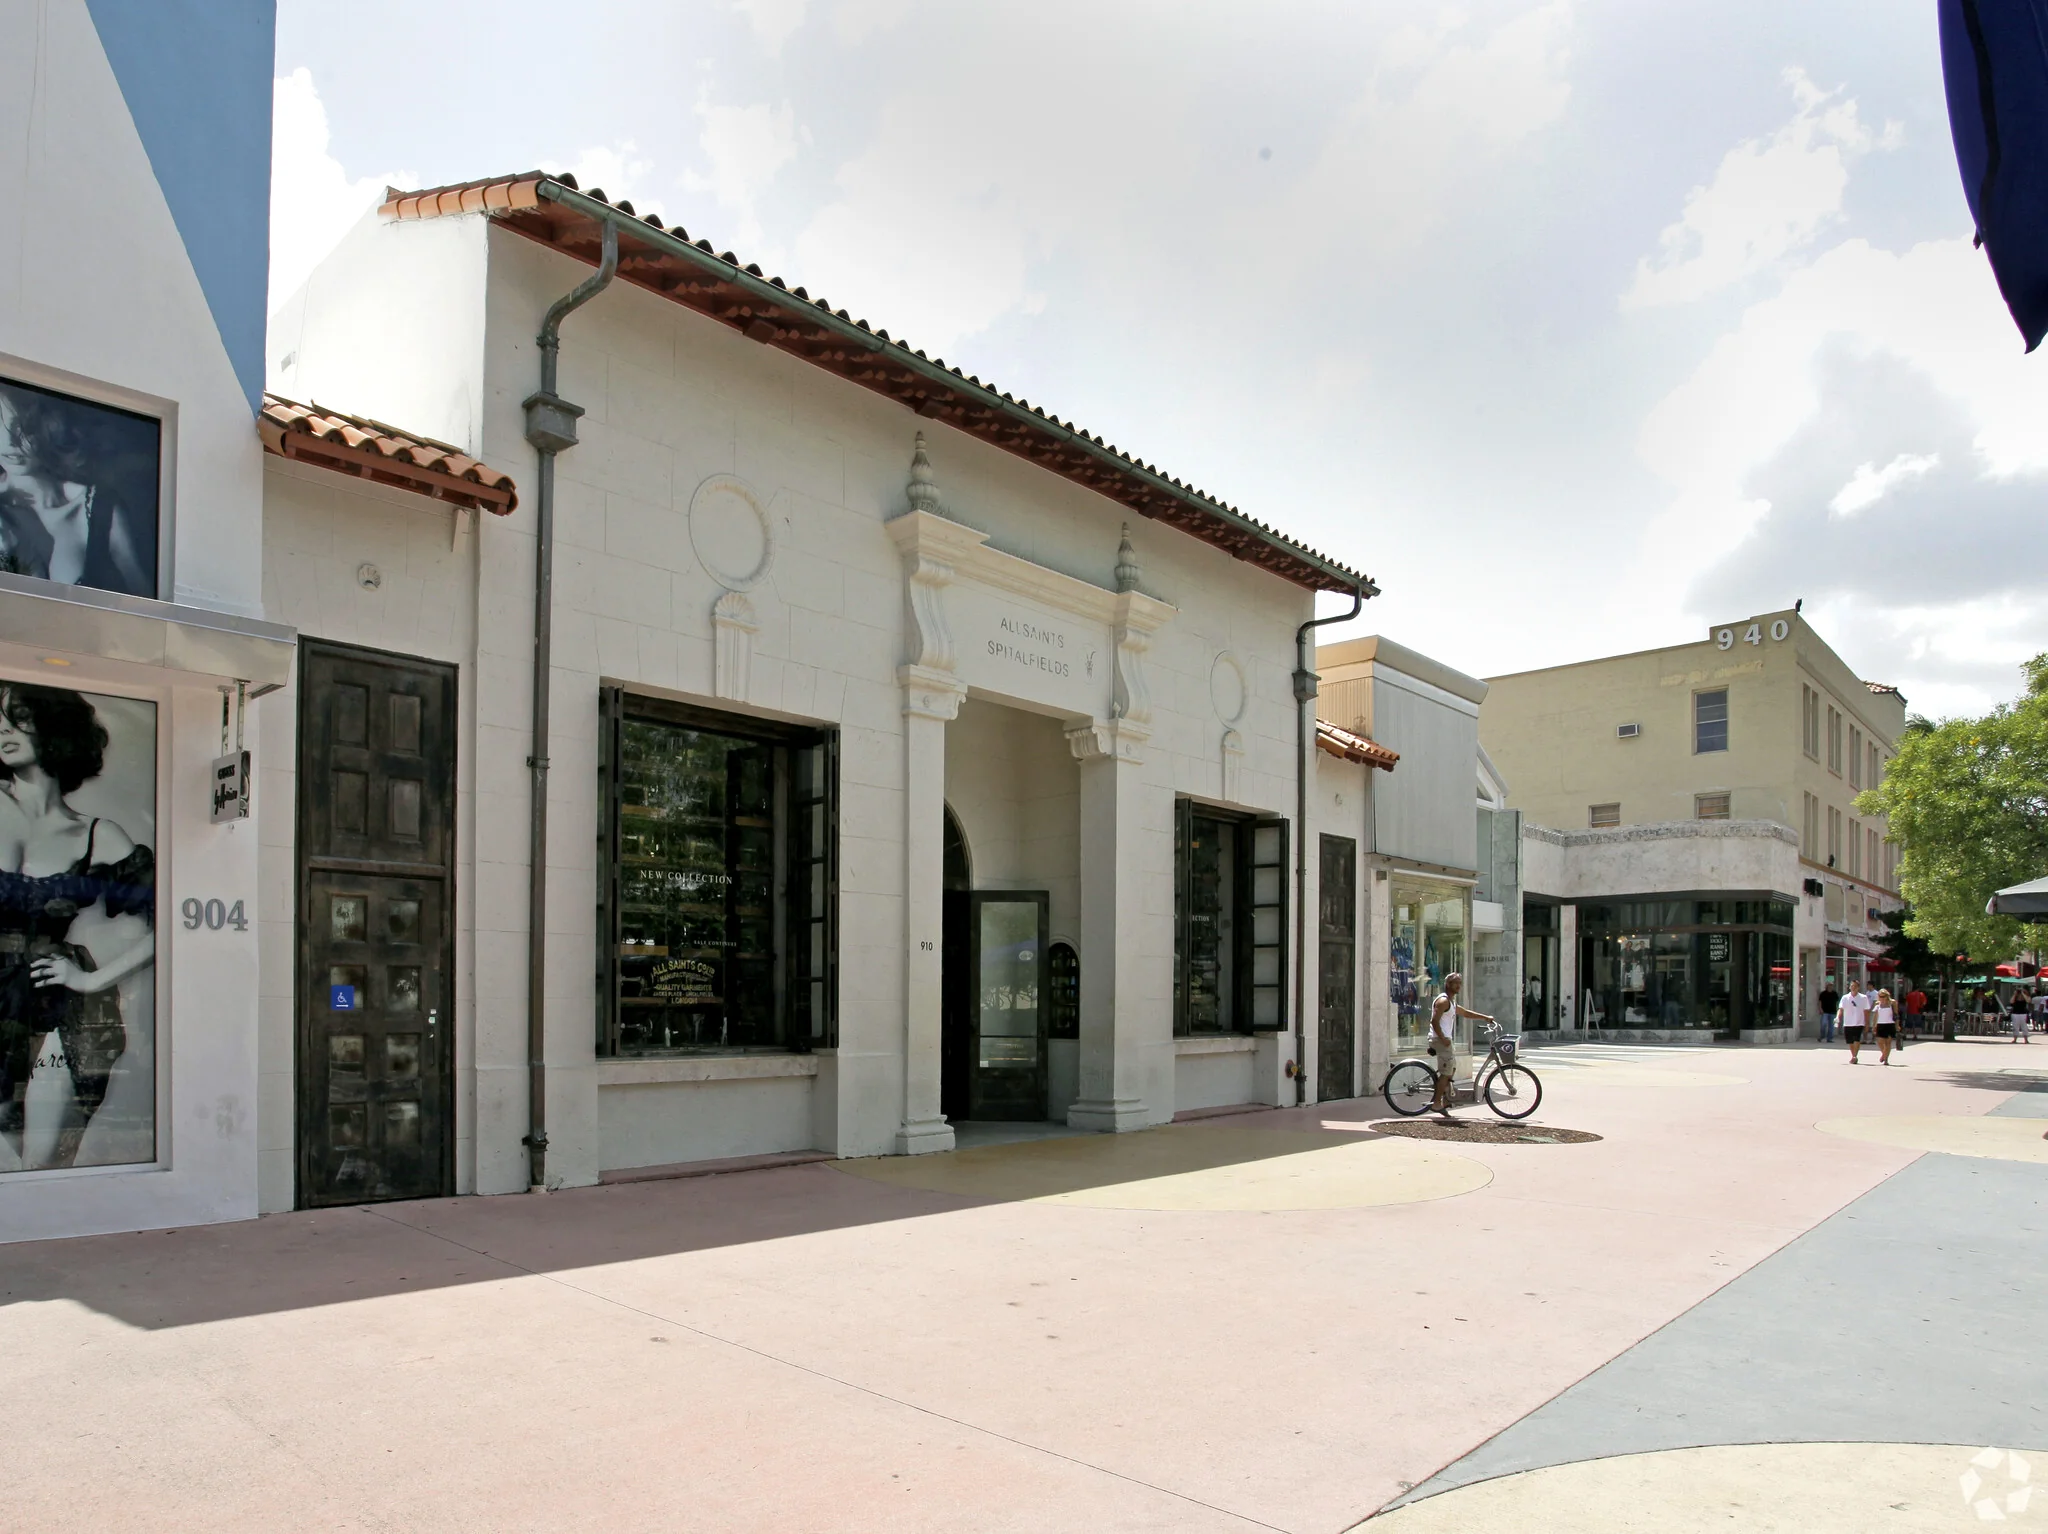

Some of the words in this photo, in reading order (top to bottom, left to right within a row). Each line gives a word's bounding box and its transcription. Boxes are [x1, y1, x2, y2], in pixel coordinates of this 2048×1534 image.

[1000, 617, 1064, 649] ALLSAINTS
[1717, 619, 1789, 651] 940
[987, 640, 1069, 677] SPITALFIELDS
[640, 869, 664, 880] NEW
[667, 871, 733, 885] COLLECTION
[182, 897, 248, 932] 904
[920, 940, 933, 951] 910
[652, 962, 668, 977] ALL
[668, 959, 696, 971] SAINTS
[1474, 955, 1510, 963] BUILDING
